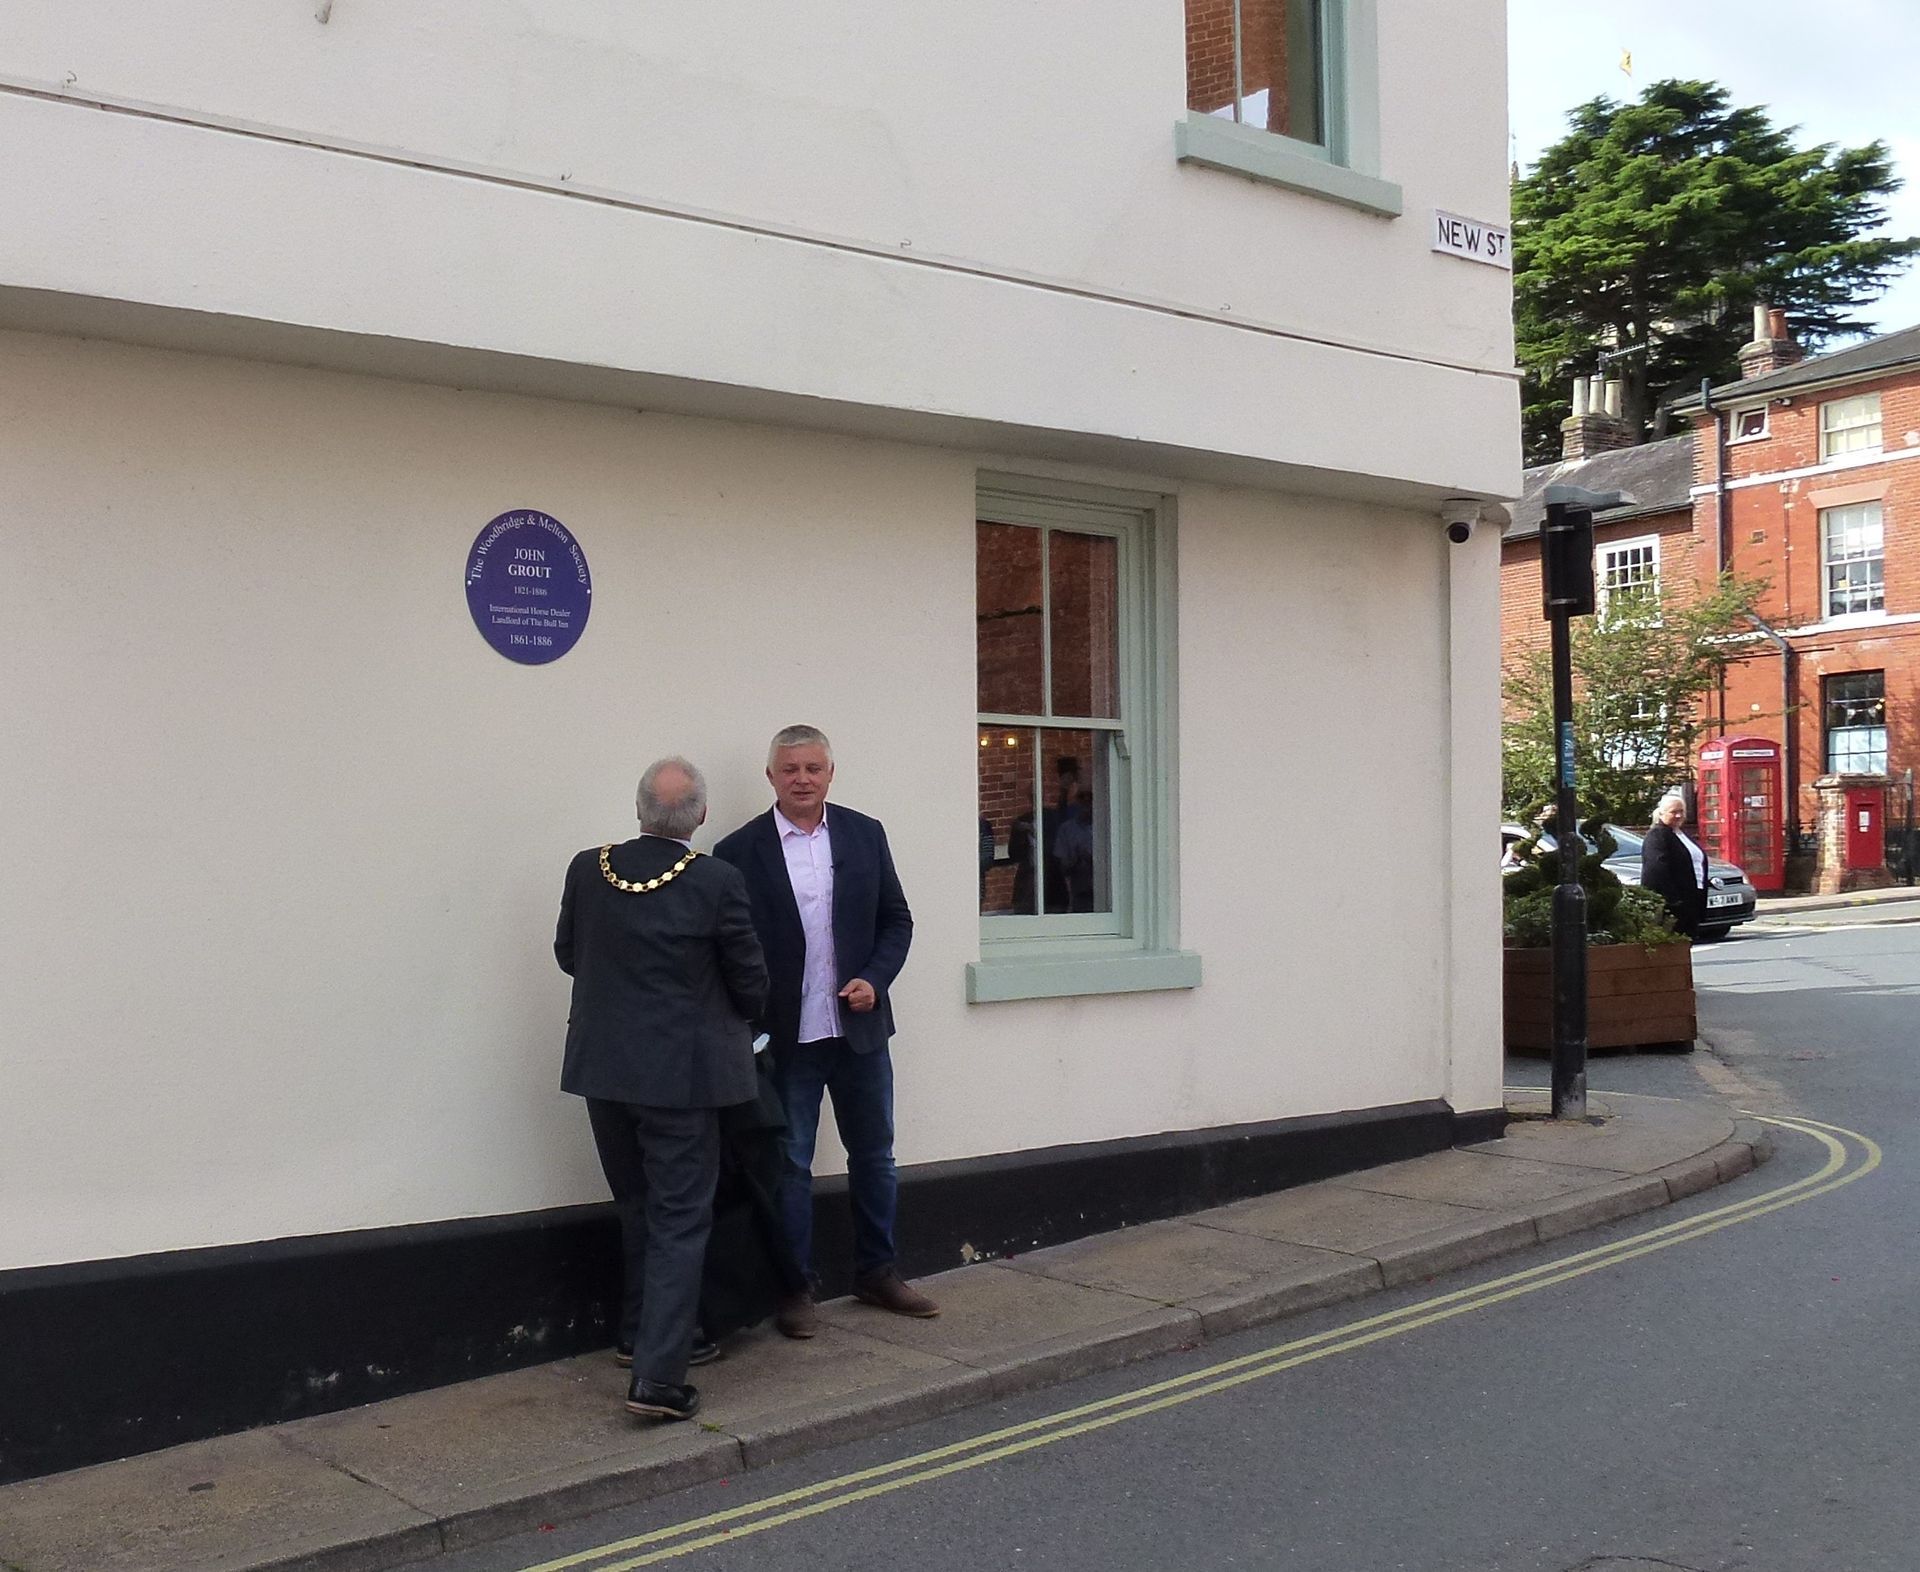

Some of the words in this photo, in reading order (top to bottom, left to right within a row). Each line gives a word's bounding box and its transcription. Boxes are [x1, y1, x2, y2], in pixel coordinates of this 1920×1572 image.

[1438, 217, 1481, 253] NEW
[526, 514, 536, 526] &
[477, 516, 525, 555] Woodbridge
[538, 516, 569, 544] Melton
[514, 548, 545, 562] JOHN
[471, 558, 485, 580] The
[508, 564, 552, 579] GROUT
[568, 543, 587, 585] Society
[489, 603, 530, 614] International
[530, 607, 549, 616] Horse
[550, 608, 571, 617] Dealer
[491, 615, 520, 625] Landlord
[521, 618, 529, 626] of
[529, 617, 543, 627] The
[543, 619, 557, 628] Bull
[558, 620, 569, 628] Inn
[510, 634, 552, 647] 1861-1886
